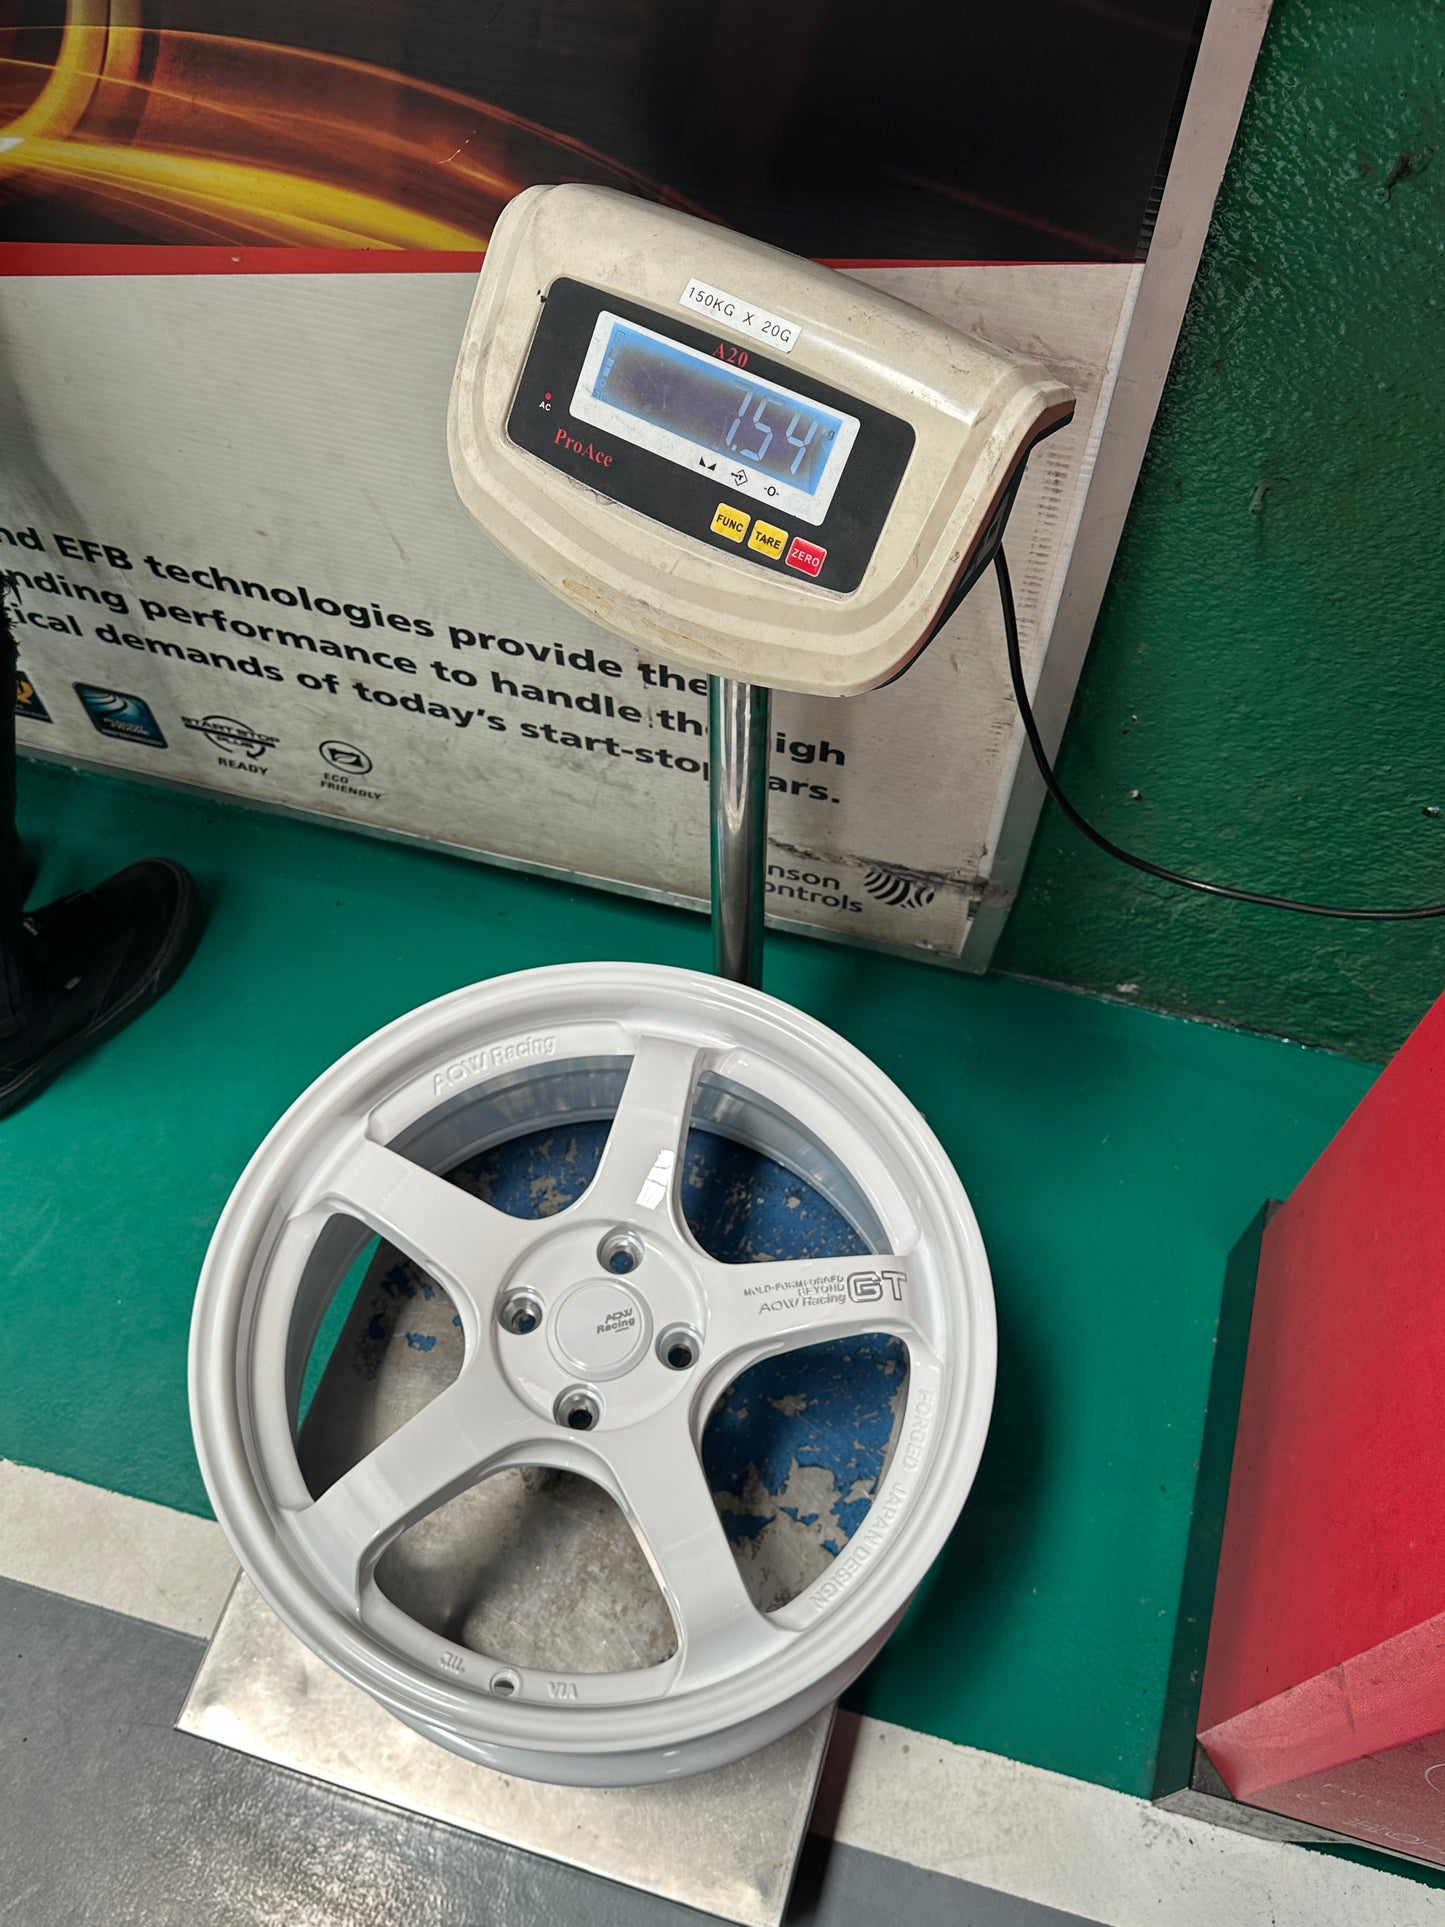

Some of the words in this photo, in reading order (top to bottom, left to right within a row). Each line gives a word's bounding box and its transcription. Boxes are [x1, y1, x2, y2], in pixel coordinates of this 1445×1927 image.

[687, 286, 736, 317] 150KG
[742, 312, 756, 326] X
[761, 320, 793, 343] 20G
[711, 342, 749, 368] A20
[538, 401, 552, 412] AC
[553, 427, 613, 468] ProAce
[716, 514, 744, 533] FUNC
[755, 531, 781, 550] TARE
[791, 548, 820, 568] ZERO
[0, 527, 46, 552] nd
[53, 534, 133, 570] EFB
[144, 555, 434, 638] technologies
[449, 625, 622, 679] provide
[638, 664, 707, 697] the
[5, 569, 129, 614] nding
[140, 599, 417, 675] performance
[430, 661, 478, 688] to
[491, 671, 642, 724] handle
[656, 709, 708, 736] th
[776, 732, 845, 766] igh
[3, 603, 83, 637] ical
[95, 623, 284, 682] demands
[297, 674, 339, 695] of
[352, 681, 507, 732] today's
[769, 776, 840, 803] ars.
[217, 757, 268, 776] READY
[323, 772, 349, 784] ECO
[320, 780, 381, 800] FRIENDLY
[768, 864, 840, 890] nson
[765, 881, 863, 913] ontrols
[490, 1036, 556, 1067] Racing
[797, 1283, 845, 1297] BEYOND
[802, 1293, 847, 1307] Racing
[846, 1270, 908, 1304] GT
[596, 1317, 636, 1334] Racing
[903, 1388, 934, 1474] FORGED
[864, 1482, 908, 1546] JAPAN
[809, 1546, 872, 1611] DESIGN
